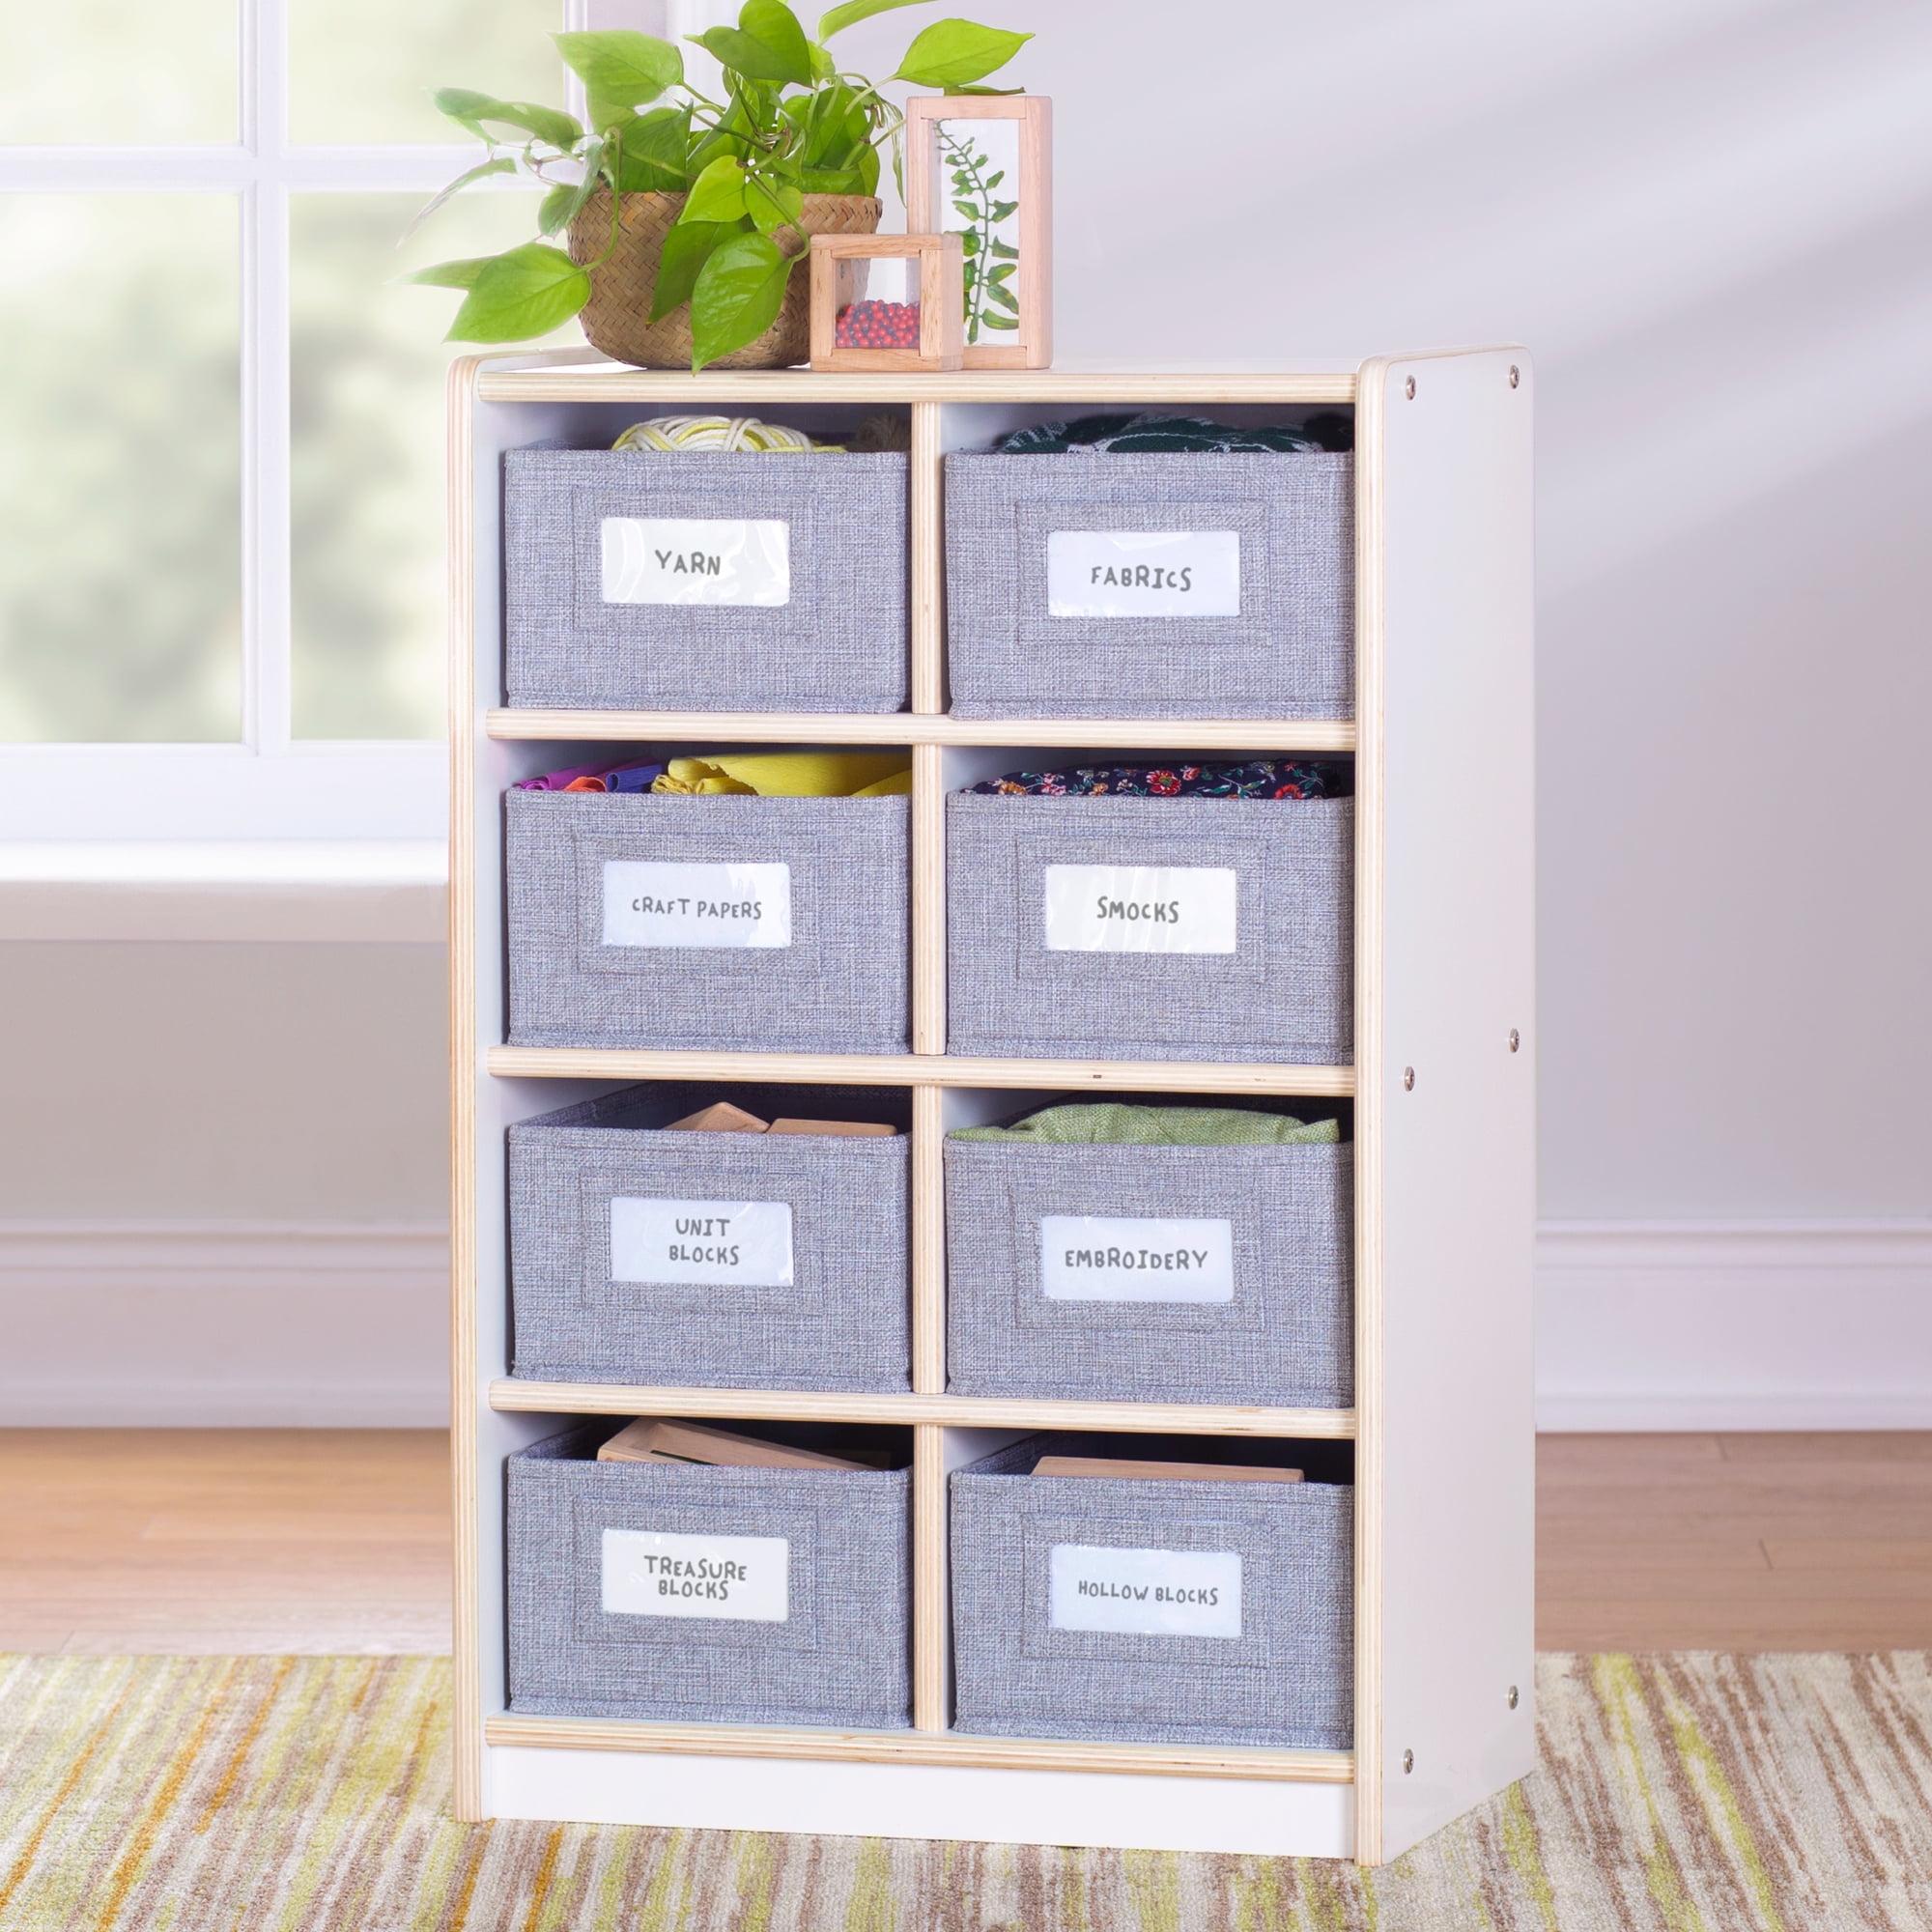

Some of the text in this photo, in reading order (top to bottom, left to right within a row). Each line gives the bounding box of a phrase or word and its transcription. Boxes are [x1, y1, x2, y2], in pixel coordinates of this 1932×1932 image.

[655, 550, 720, 575] YARN
[1092, 565, 1192, 591] FABRICS
[632, 896, 761, 919] CRAFT PAPERS
[1097, 896, 1179, 923] SMOCKS
[675, 1218, 730, 1236] UNIT
[669, 1244, 740, 1265] BLOCKS
[1065, 1249, 1208, 1270] EMBROIDERY
[644, 1555, 747, 1580] TREASURE
[659, 1578, 729, 1601] BLOCKS
[1078, 1580, 1218, 1606] HOLLOW BLOCKS
